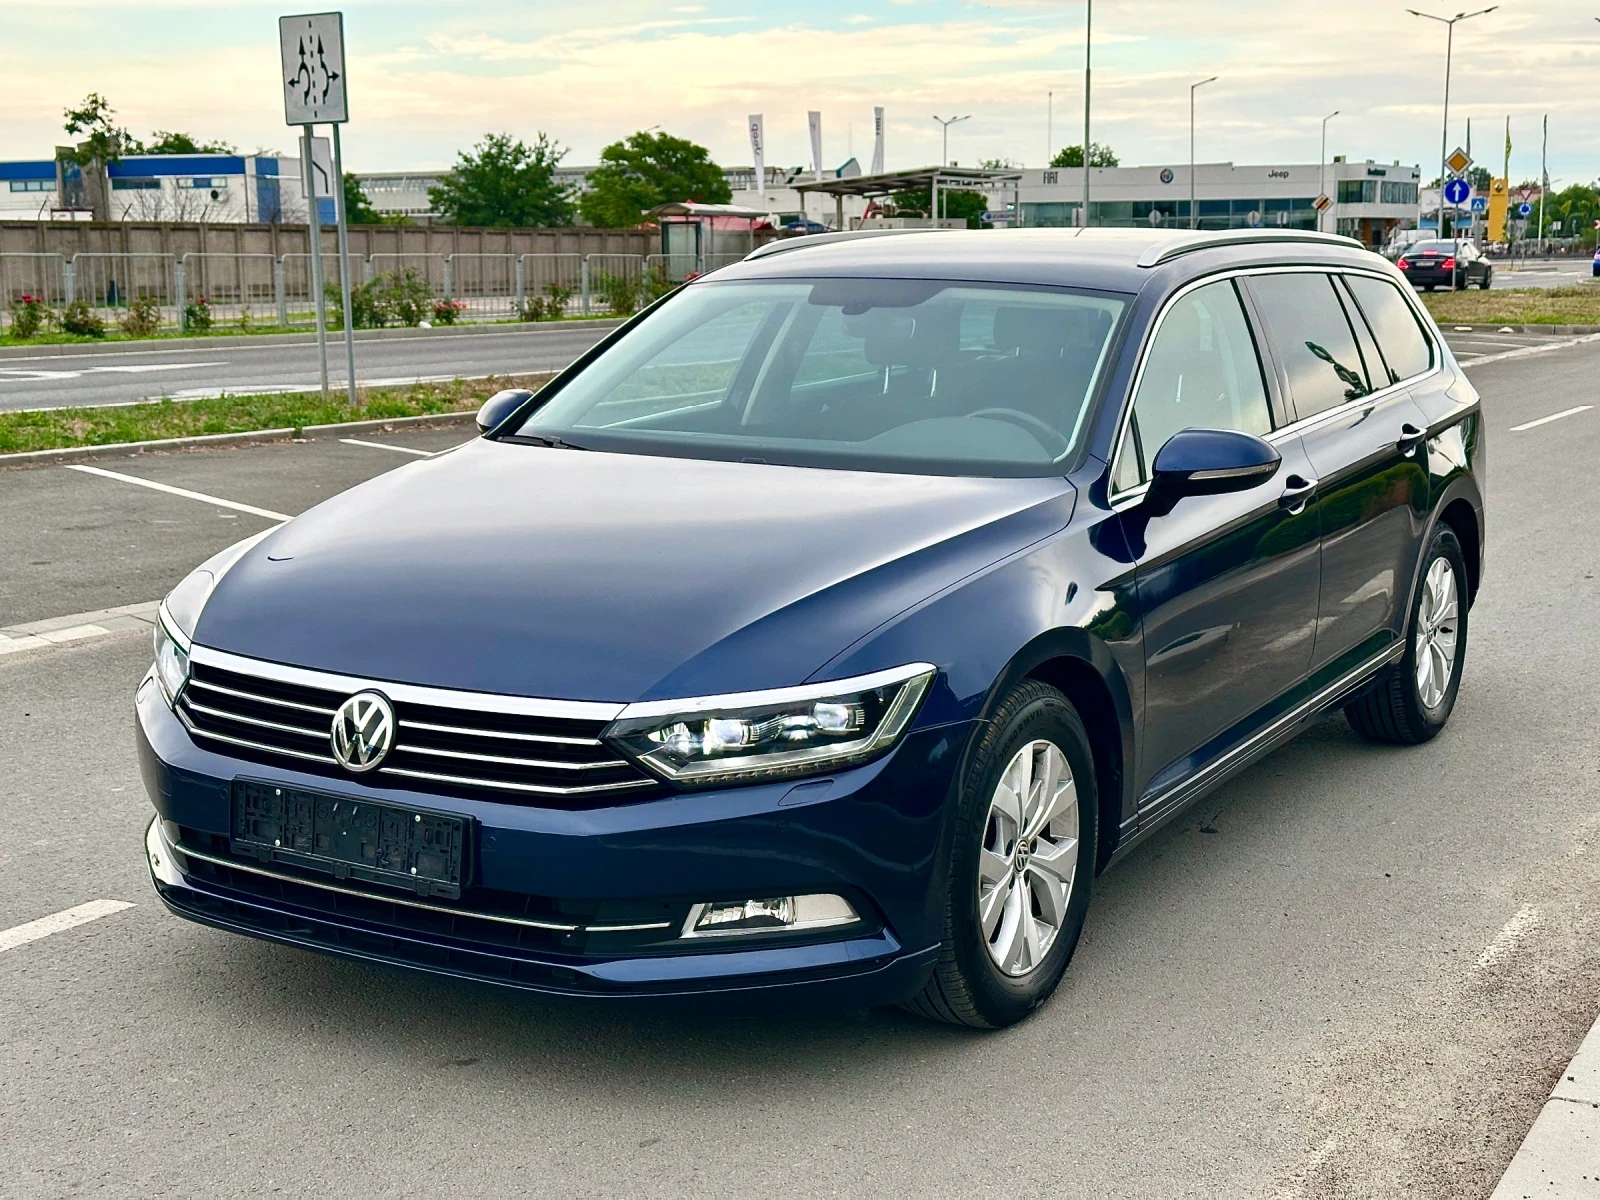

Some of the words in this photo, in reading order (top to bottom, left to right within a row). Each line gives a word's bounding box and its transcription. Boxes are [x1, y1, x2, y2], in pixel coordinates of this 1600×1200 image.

[1043, 171, 1058, 184] FIAT
[1268, 169, 1289, 179] Jeep
[333, 694, 391, 770] VW
